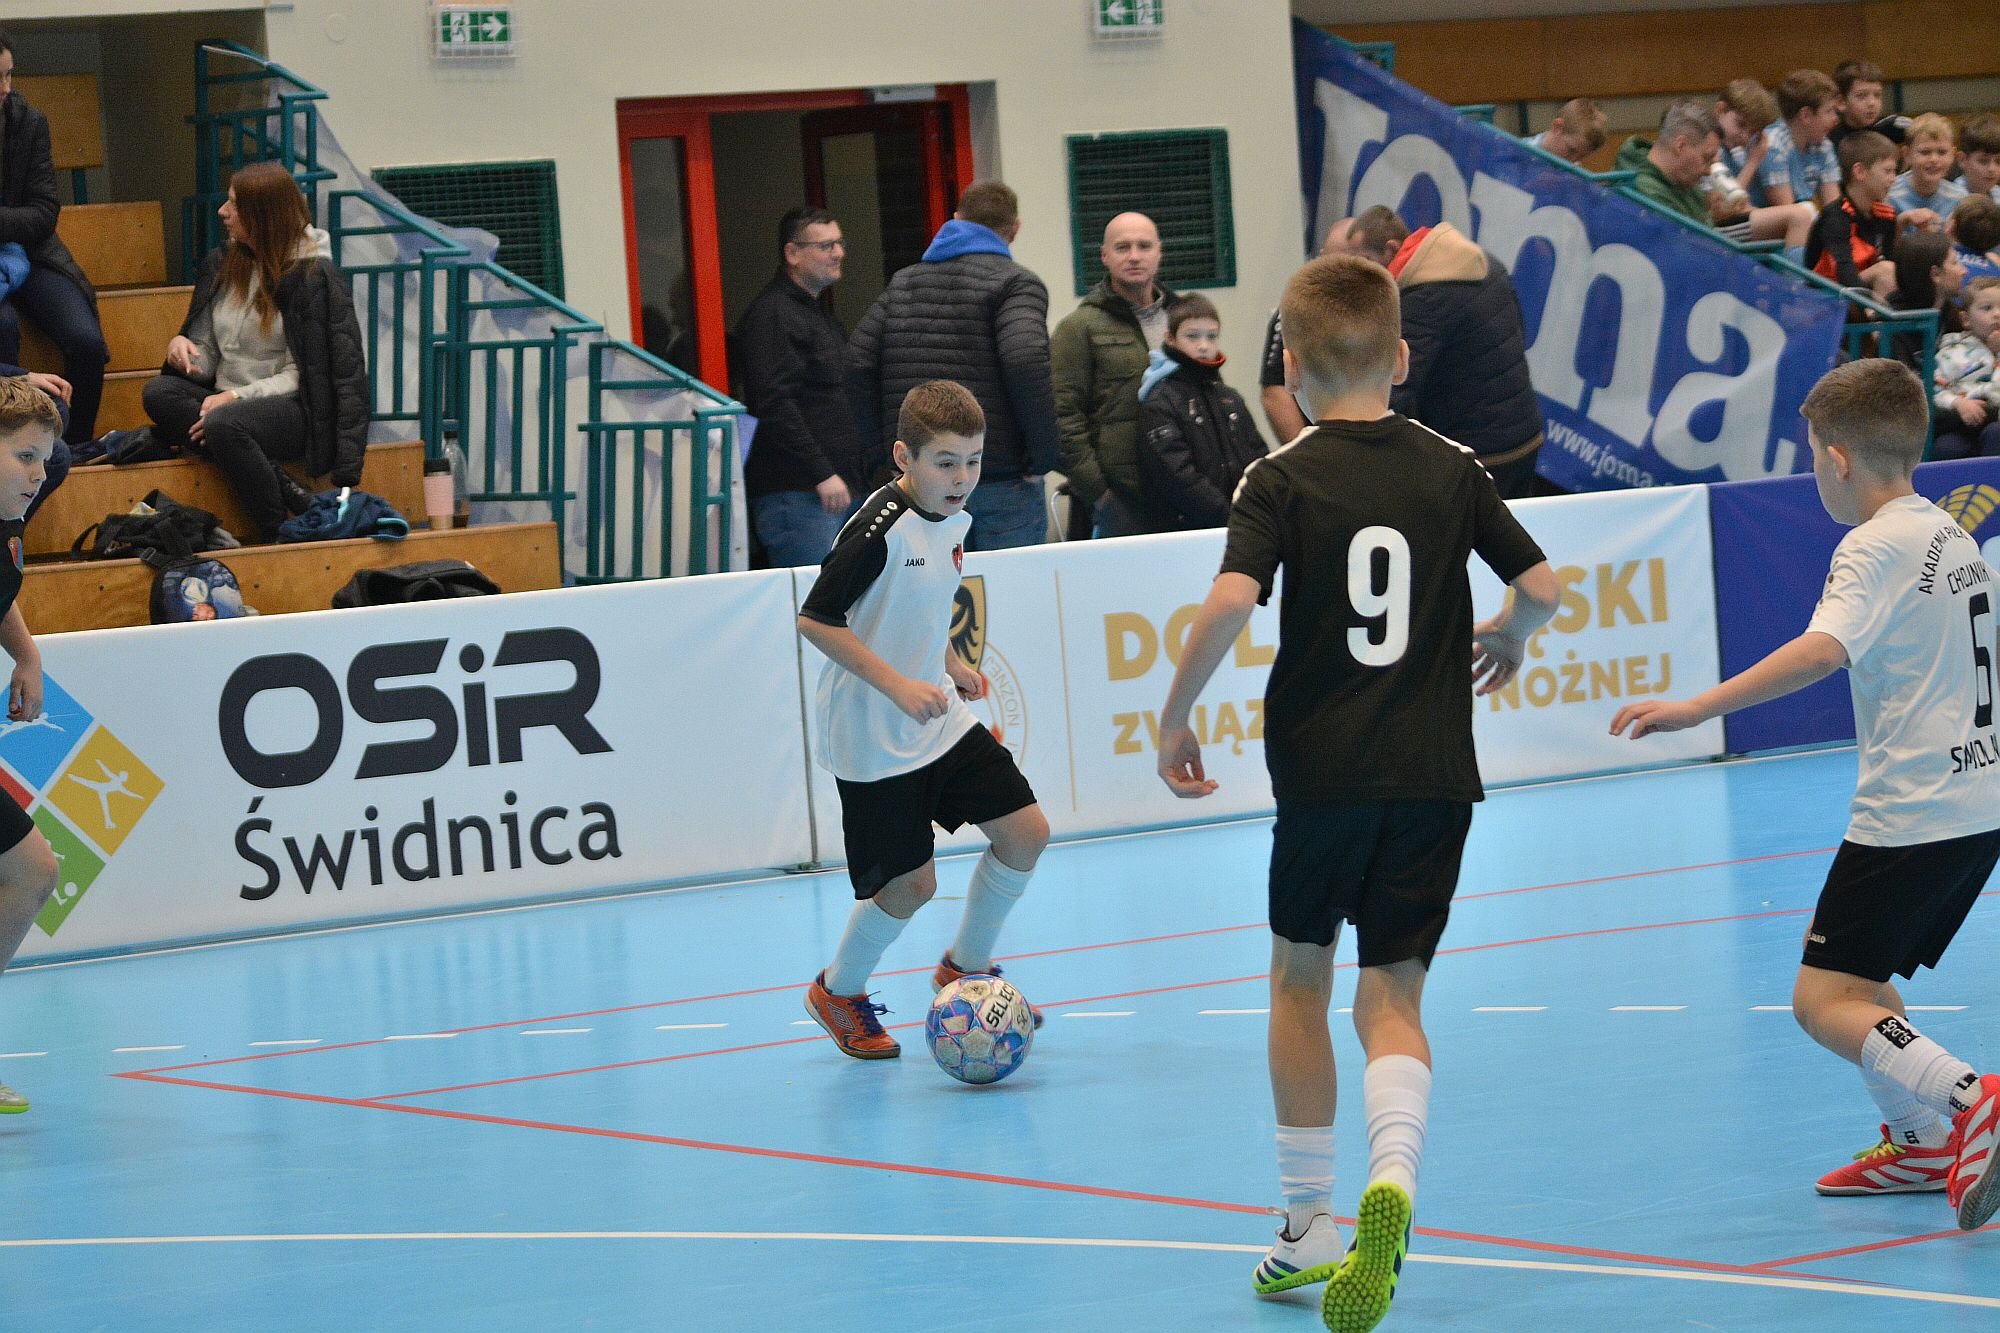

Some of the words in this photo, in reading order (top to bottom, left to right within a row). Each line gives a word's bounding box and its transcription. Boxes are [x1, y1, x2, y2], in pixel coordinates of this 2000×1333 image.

[904, 557, 925, 568] JAKO
[1347, 525, 1411, 666] 9
[219, 626, 614, 788] OSiR
[1969, 591, 1993, 729] 6
[235, 790, 623, 901] Świdnica
